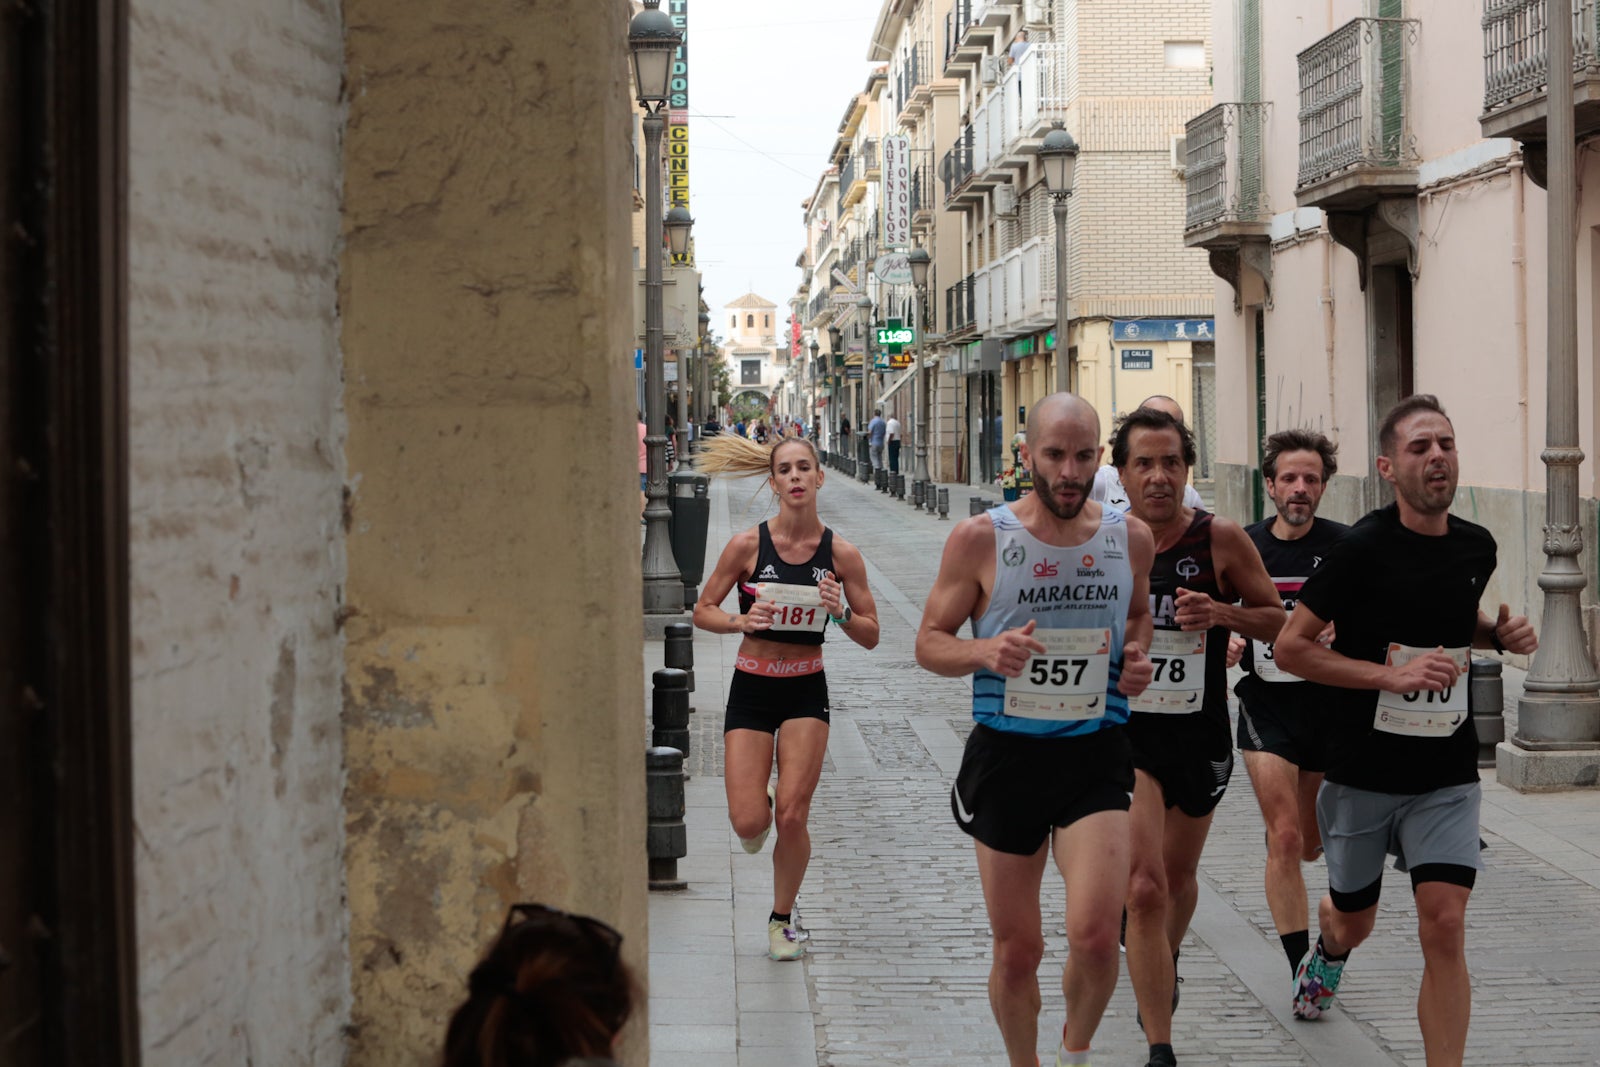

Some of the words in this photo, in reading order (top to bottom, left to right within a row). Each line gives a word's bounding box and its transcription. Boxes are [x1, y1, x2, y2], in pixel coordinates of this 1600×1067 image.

[672, 127, 687, 206] CONFE
[886, 139, 896, 243] AUTENTICOS
[898, 140, 908, 243] PIONONOS
[1131, 350, 1151, 358] CALLE
[1018, 585, 1119, 604] MARACENA
[781, 606, 816, 625] 181
[737, 656, 759, 670] RO
[766, 660, 809, 674] NIKE
[1029, 658, 1089, 686] 557
